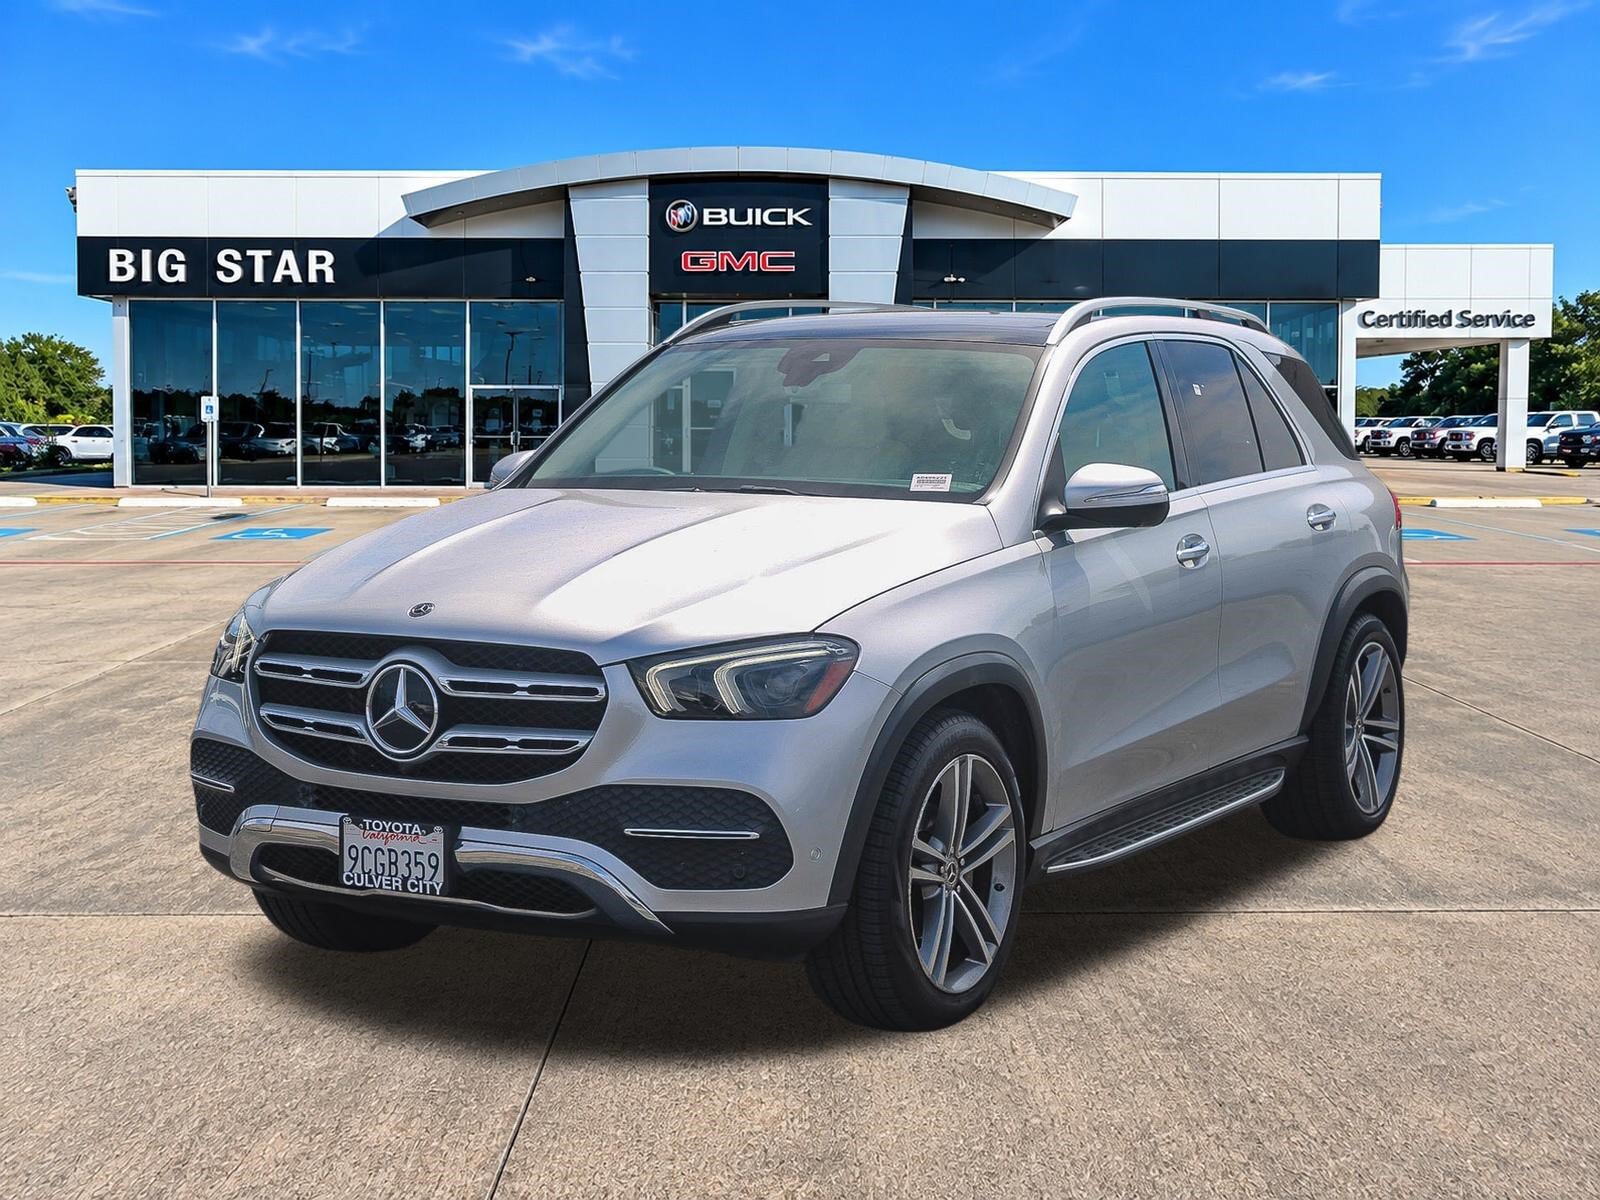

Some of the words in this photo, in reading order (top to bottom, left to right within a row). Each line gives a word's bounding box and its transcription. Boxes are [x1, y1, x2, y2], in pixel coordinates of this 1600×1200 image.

[703, 208, 813, 226] BUICK
[108, 248, 187, 283] BIG
[215, 248, 336, 283] STAR
[681, 250, 796, 272] GMC
[1361, 309, 1453, 328] Certified
[1456, 309, 1536, 328] Service
[363, 819, 422, 836] TOYOTA
[348, 844, 440, 882] 9CGB359
[343, 871, 402, 891] CULVER
[407, 880, 443, 896] CITY
